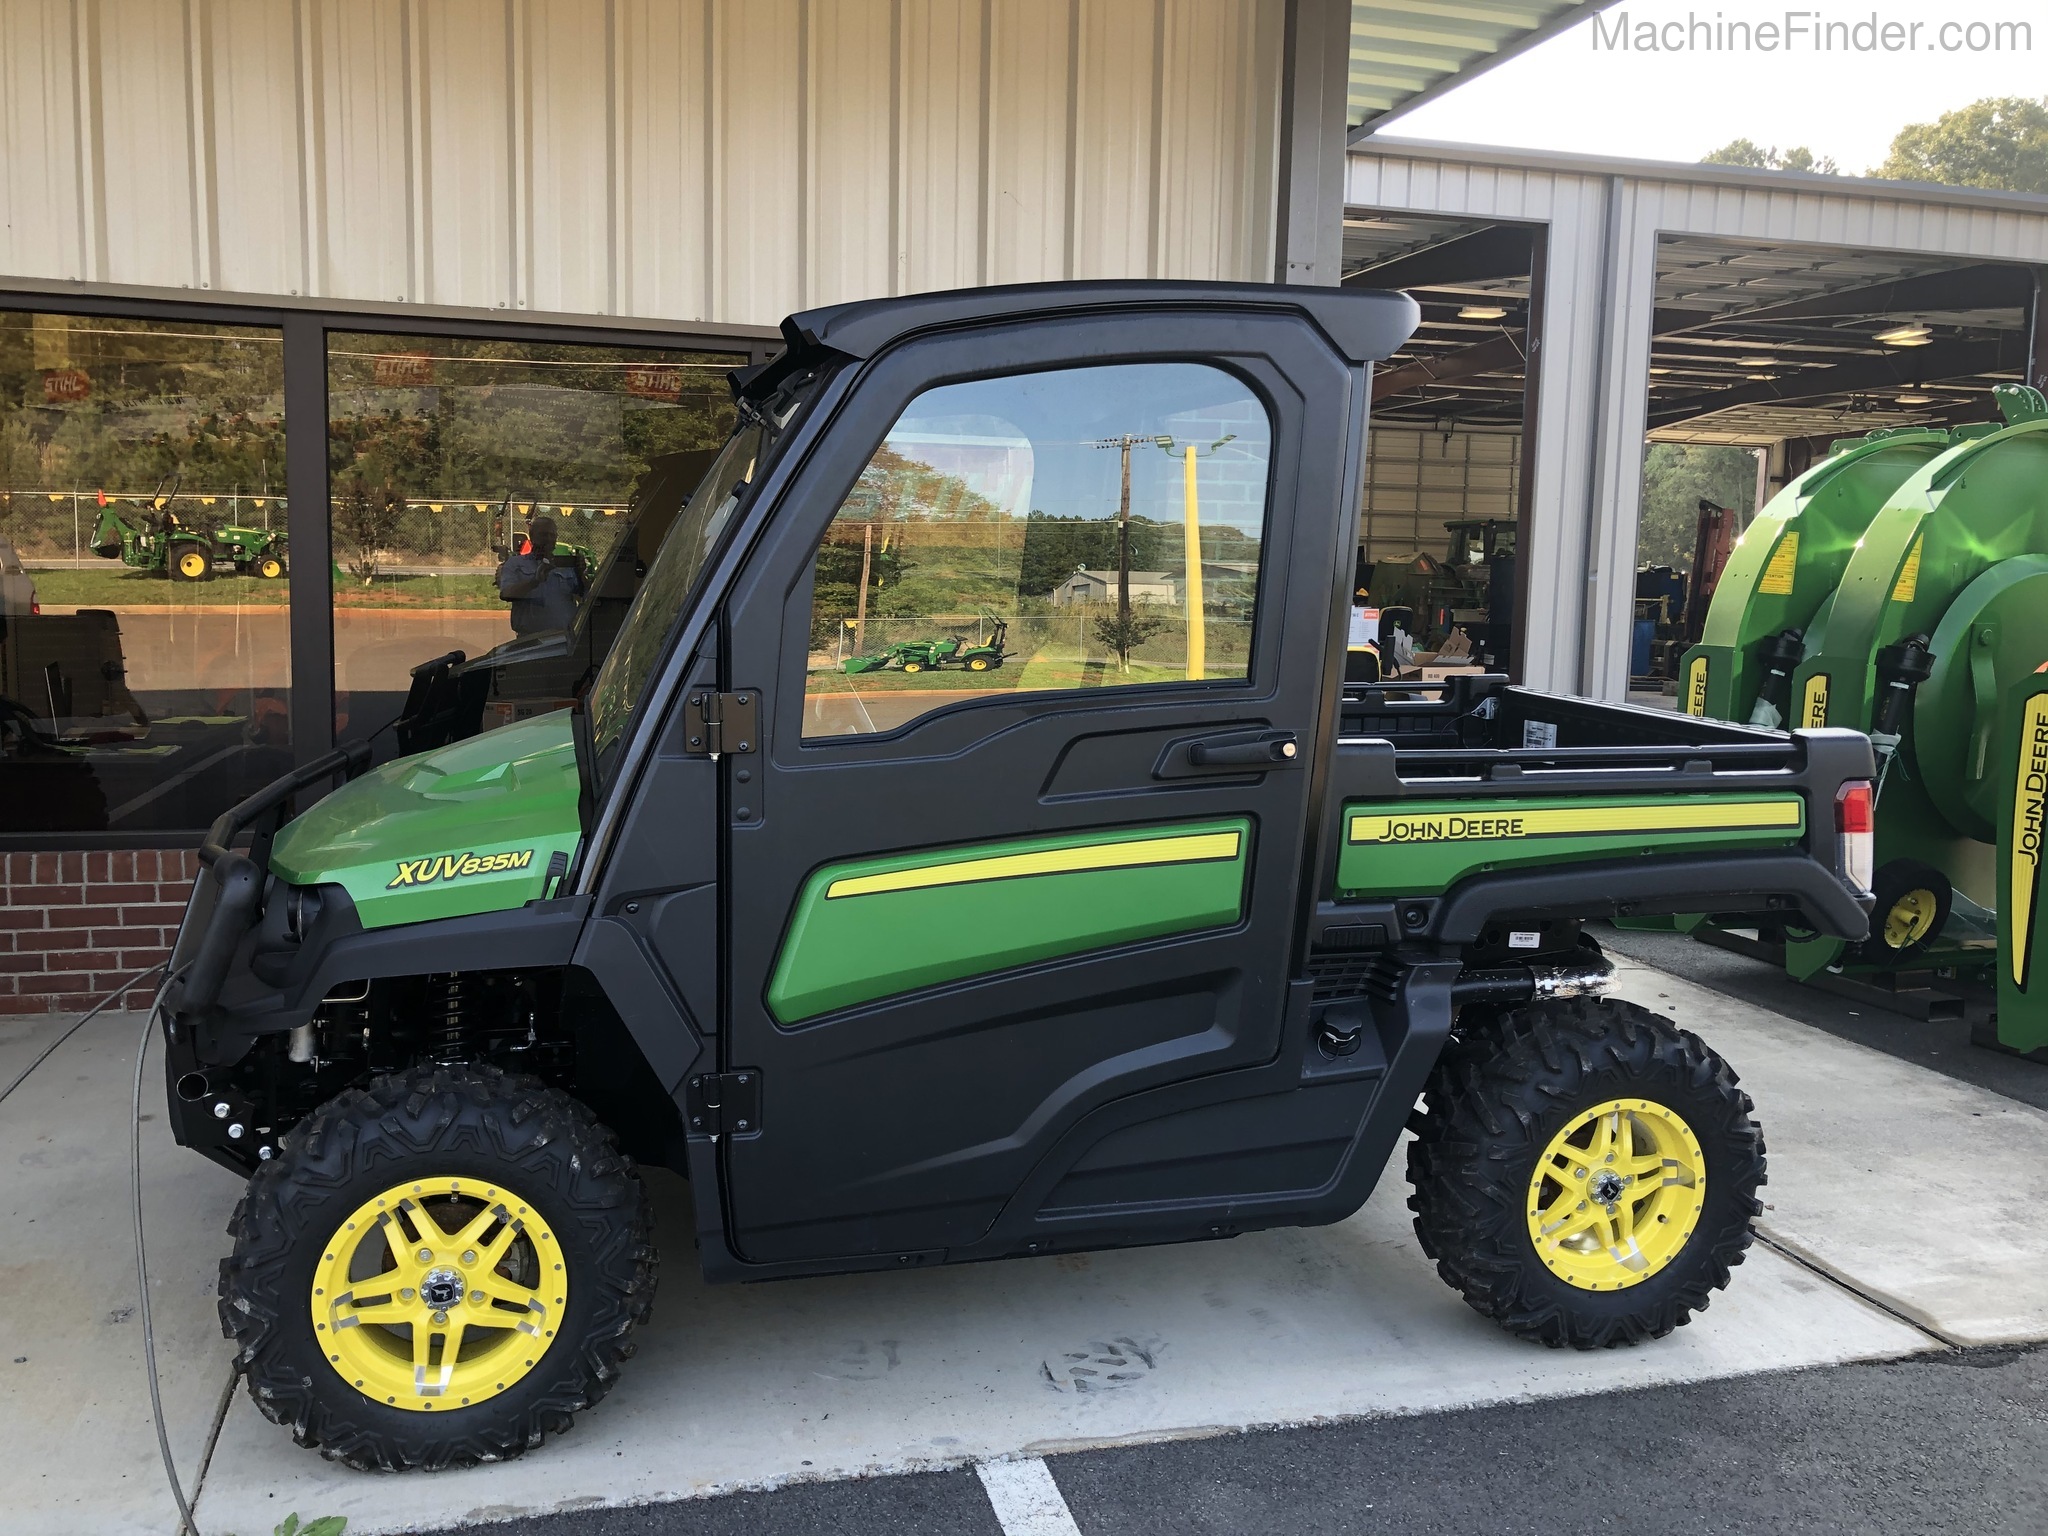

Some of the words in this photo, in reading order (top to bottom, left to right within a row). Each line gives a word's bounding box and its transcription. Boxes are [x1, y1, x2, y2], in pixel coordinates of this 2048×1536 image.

[44, 376, 81, 393] STIHL
[1693, 672, 1706, 717] EERE
[1811, 691, 1825, 728] ERE
[2025, 712, 2048, 792] DEERE
[1379, 820, 1442, 840] JOHN
[1449, 817, 1524, 837] DEERE
[2018, 798, 2042, 866] JOHN
[386, 848, 534, 890] XUV835M
